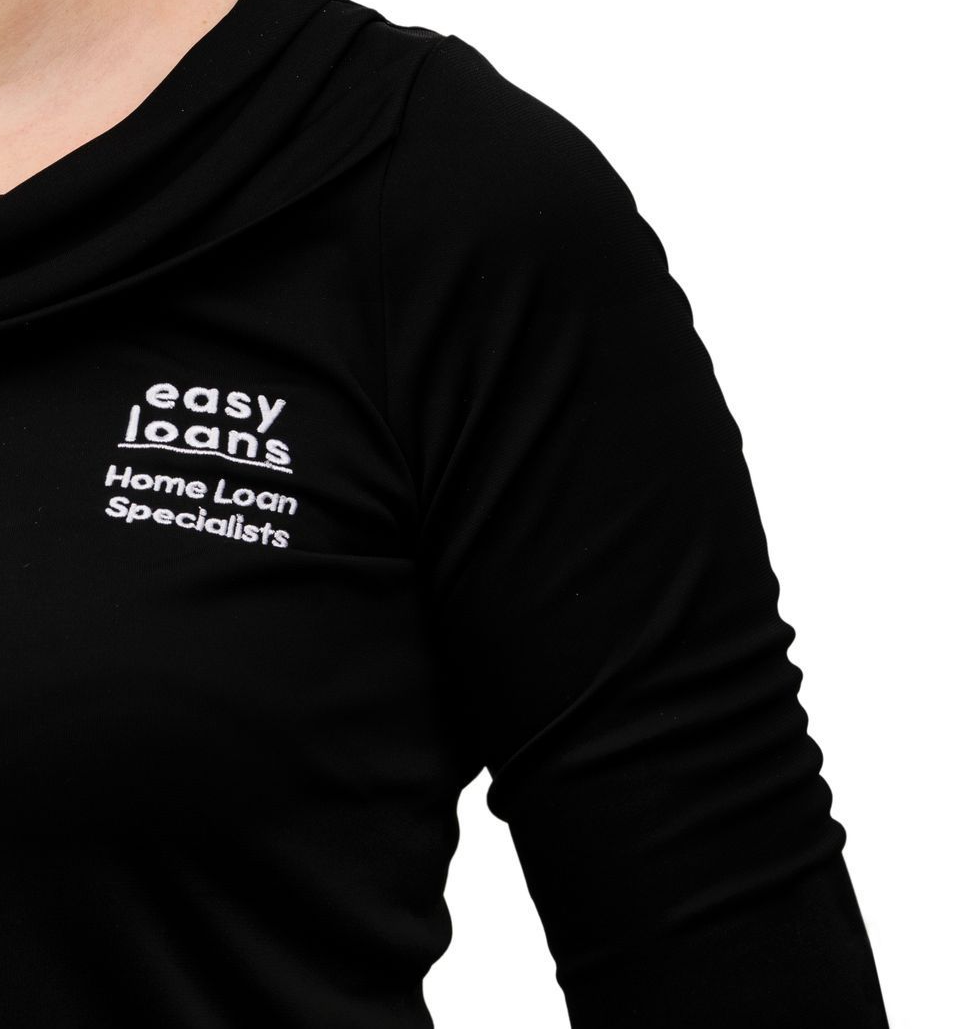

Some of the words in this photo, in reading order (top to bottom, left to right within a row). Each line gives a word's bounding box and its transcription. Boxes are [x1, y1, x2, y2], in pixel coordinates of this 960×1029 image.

[145, 382, 287, 434] easy
[124, 404, 292, 466] loans
[104, 464, 208, 500] Home
[213, 478, 298, 516] Loan
[104, 495, 290, 549] Specialists
